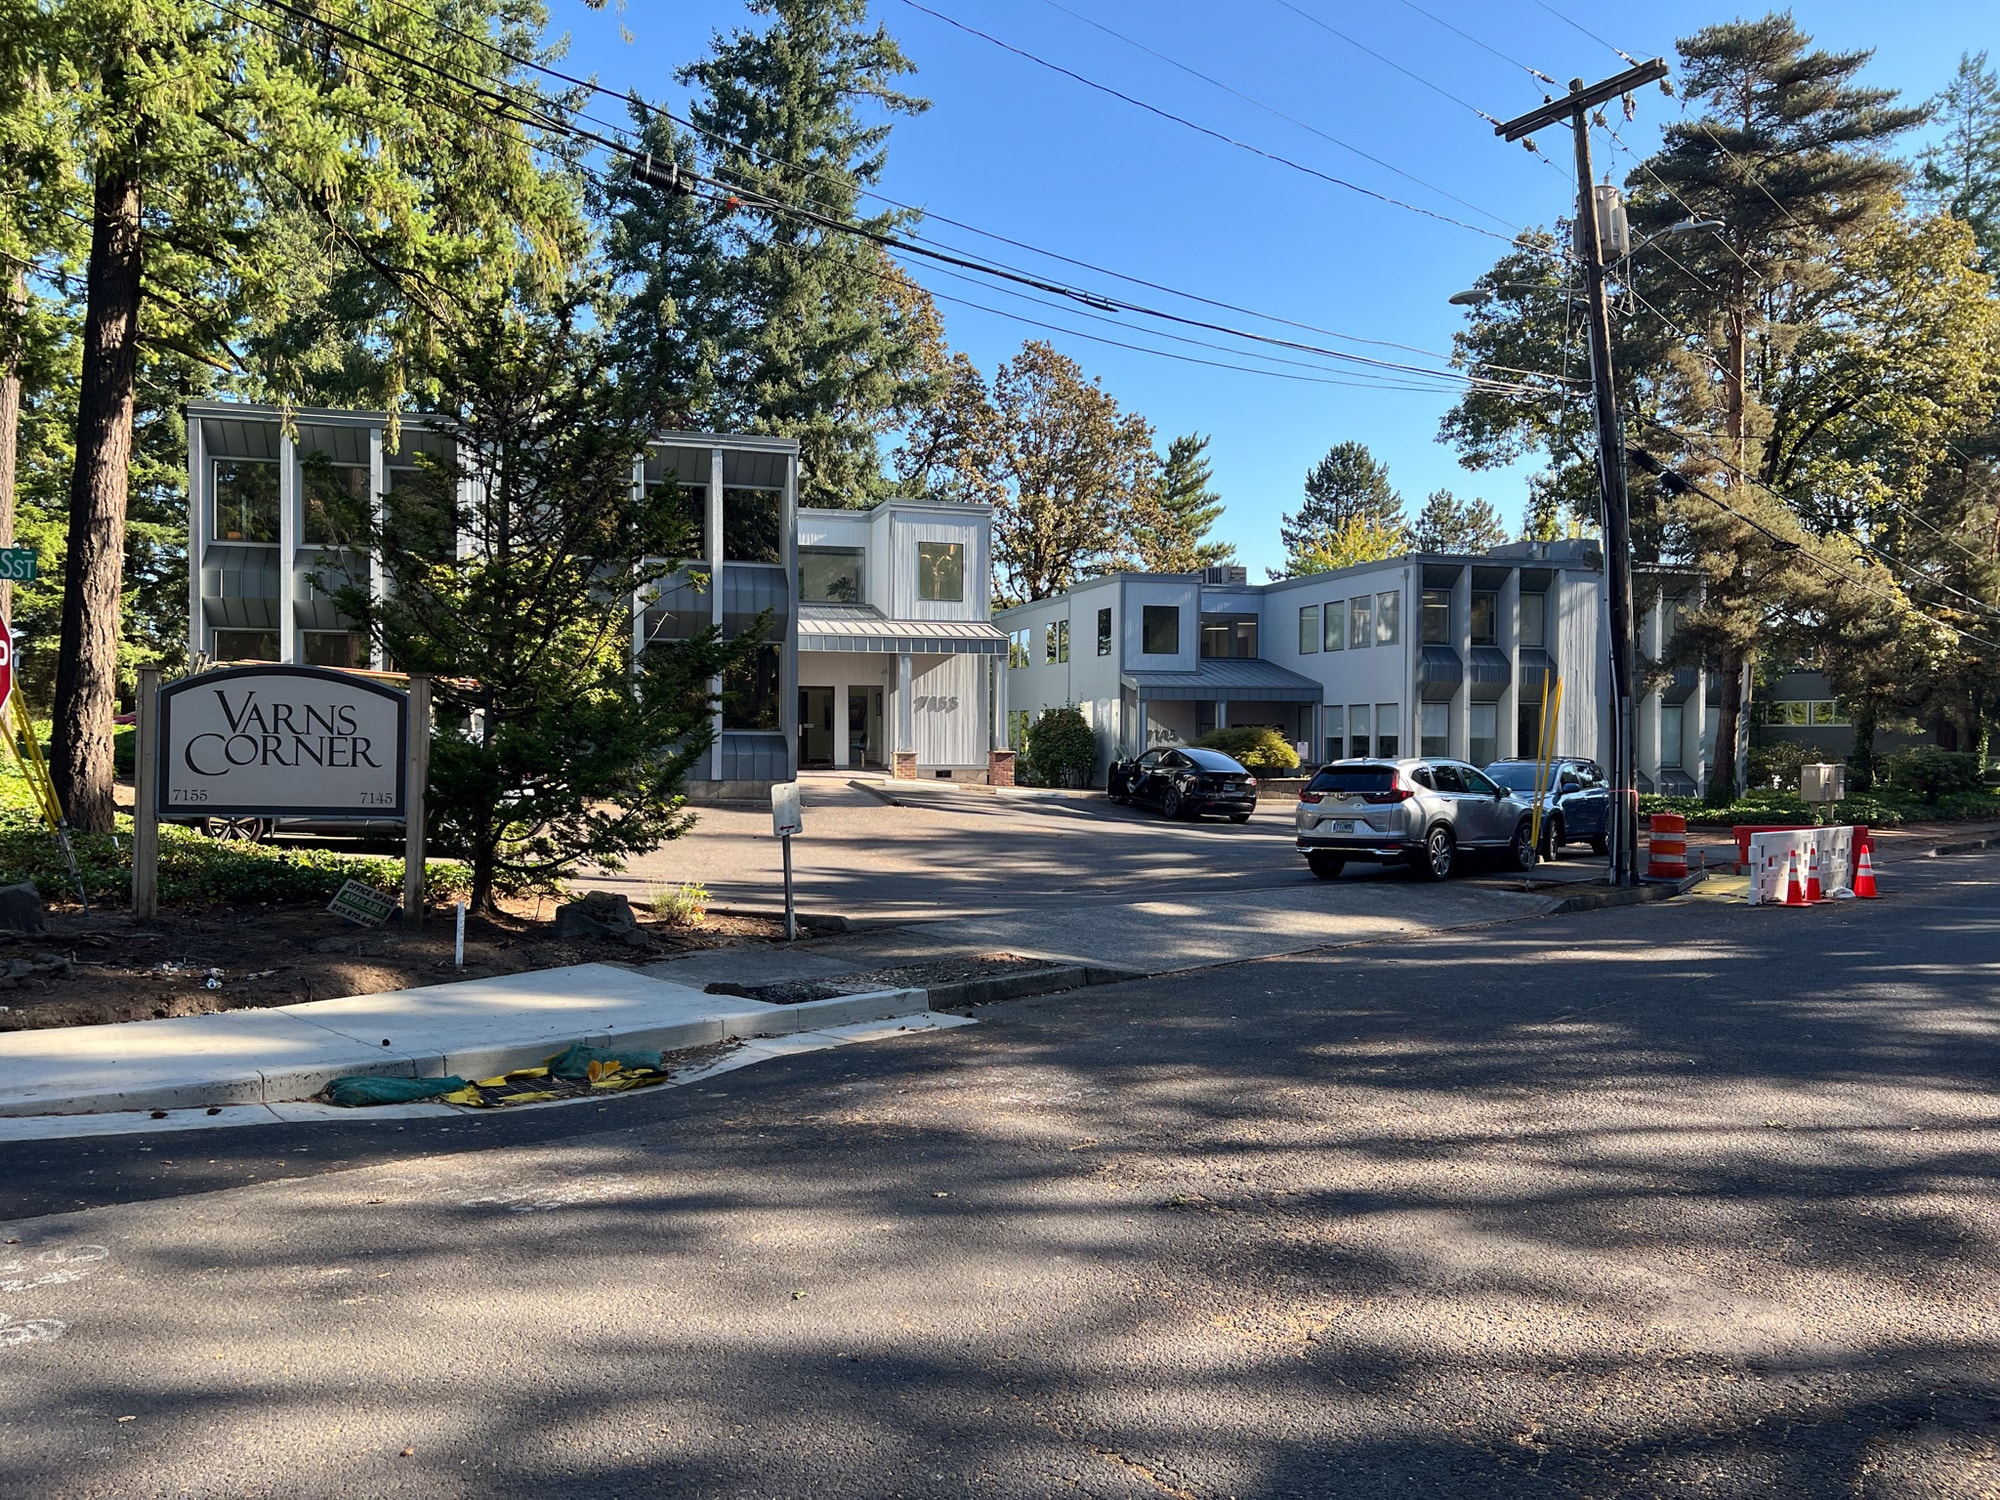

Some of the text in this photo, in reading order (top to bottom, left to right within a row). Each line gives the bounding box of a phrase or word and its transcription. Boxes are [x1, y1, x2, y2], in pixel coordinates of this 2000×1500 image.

[213, 690, 358, 736] VARNS
[912, 695, 959, 713] 7155
[184, 733, 382, 776] CORNER
[173, 789, 208, 801] 7155
[360, 792, 393, 804] 7145
[342, 892, 389, 915] AVAILABLE
[347, 882, 396, 906] OFFICE SPACE
